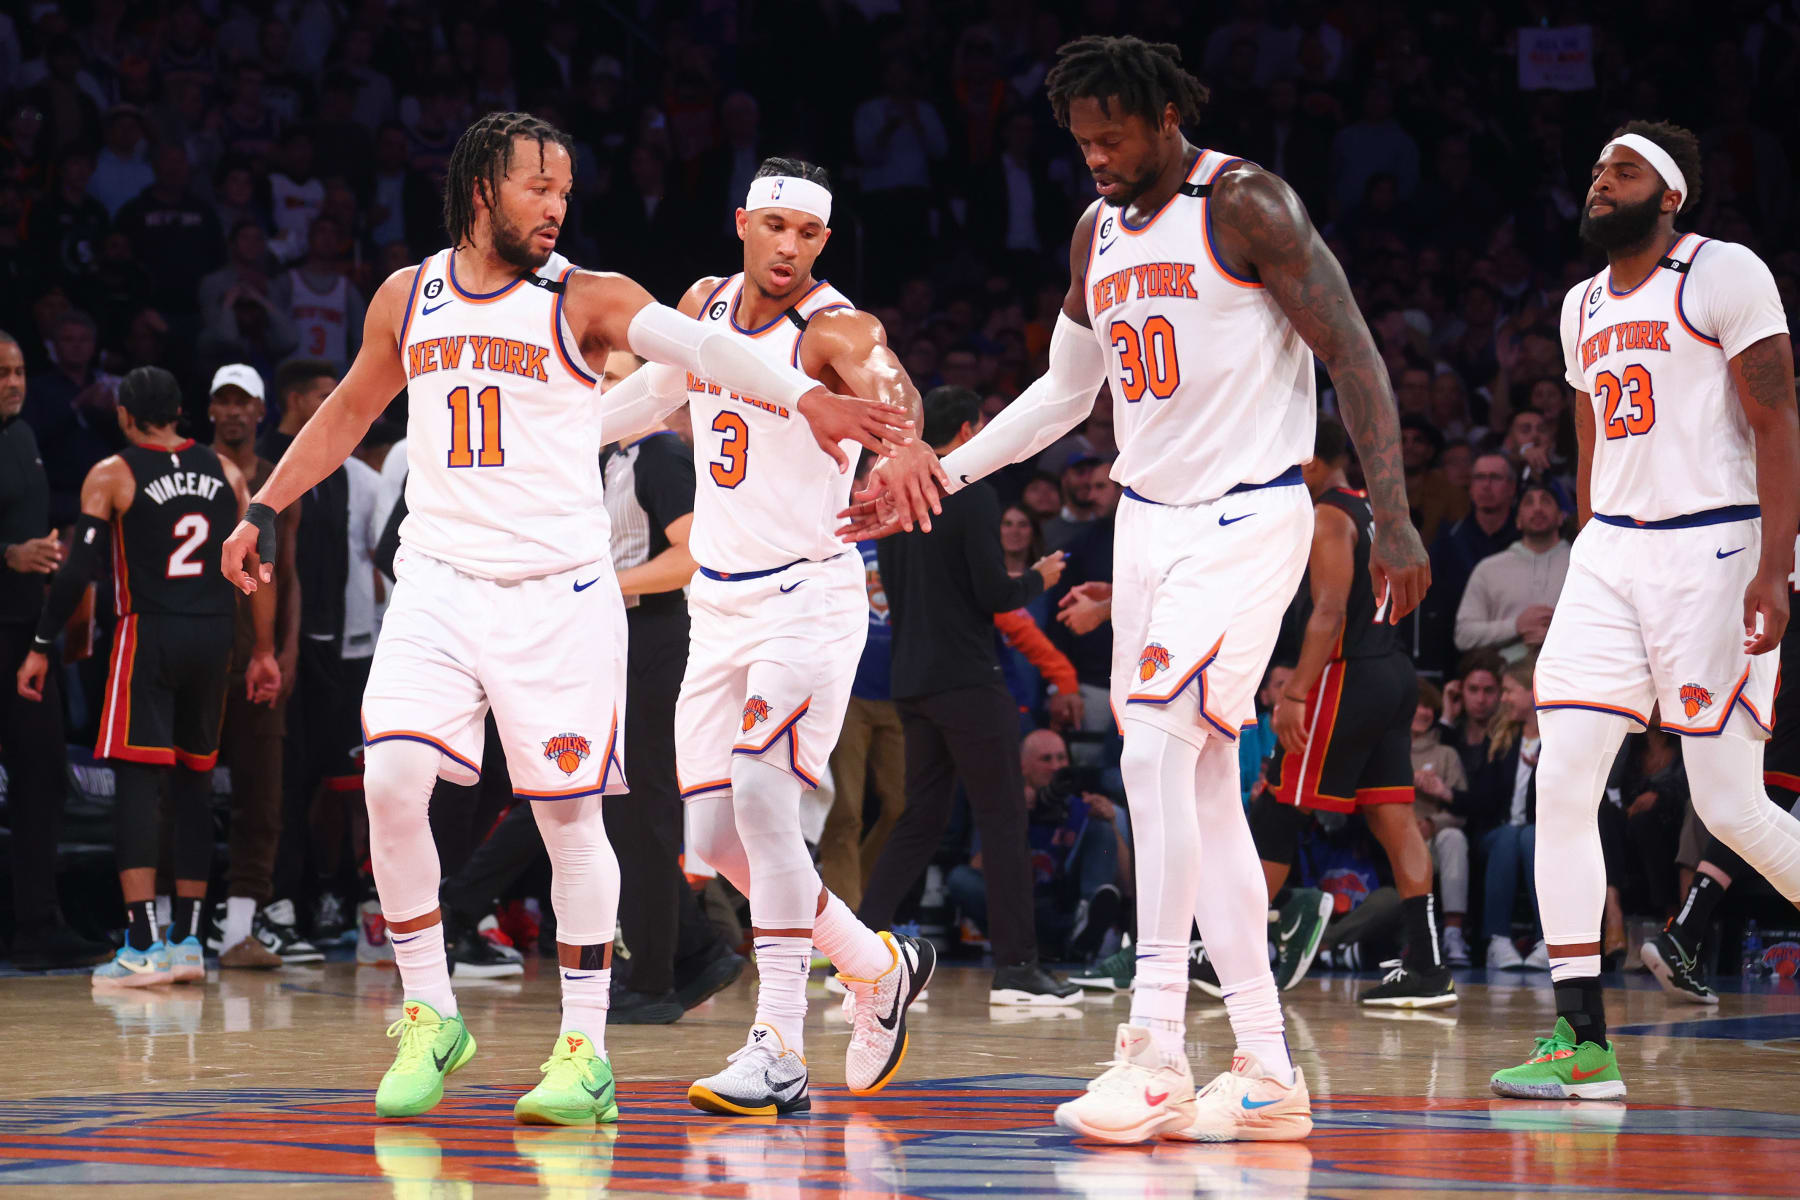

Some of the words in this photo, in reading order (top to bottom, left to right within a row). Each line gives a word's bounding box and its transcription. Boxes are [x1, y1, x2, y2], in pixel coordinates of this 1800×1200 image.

[426, 280, 442, 298] 6
[711, 303, 726, 319] 6
[1093, 266, 1132, 316] NEW
[1134, 262, 1198, 300] YORK
[408, 336, 466, 380] NEW
[469, 335, 549, 383] YORK
[1110, 315, 1180, 403] 30
[1582, 324, 1615, 372] NEW
[1615, 321, 1671, 352] YORK
[447, 386, 505, 468] 11
[1595, 364, 1656, 440] 23
[710, 409, 748, 490] 3
[144, 472, 224, 505] VINCENT
[165, 512, 210, 579] 2
[544, 735, 591, 757] KNICKS
